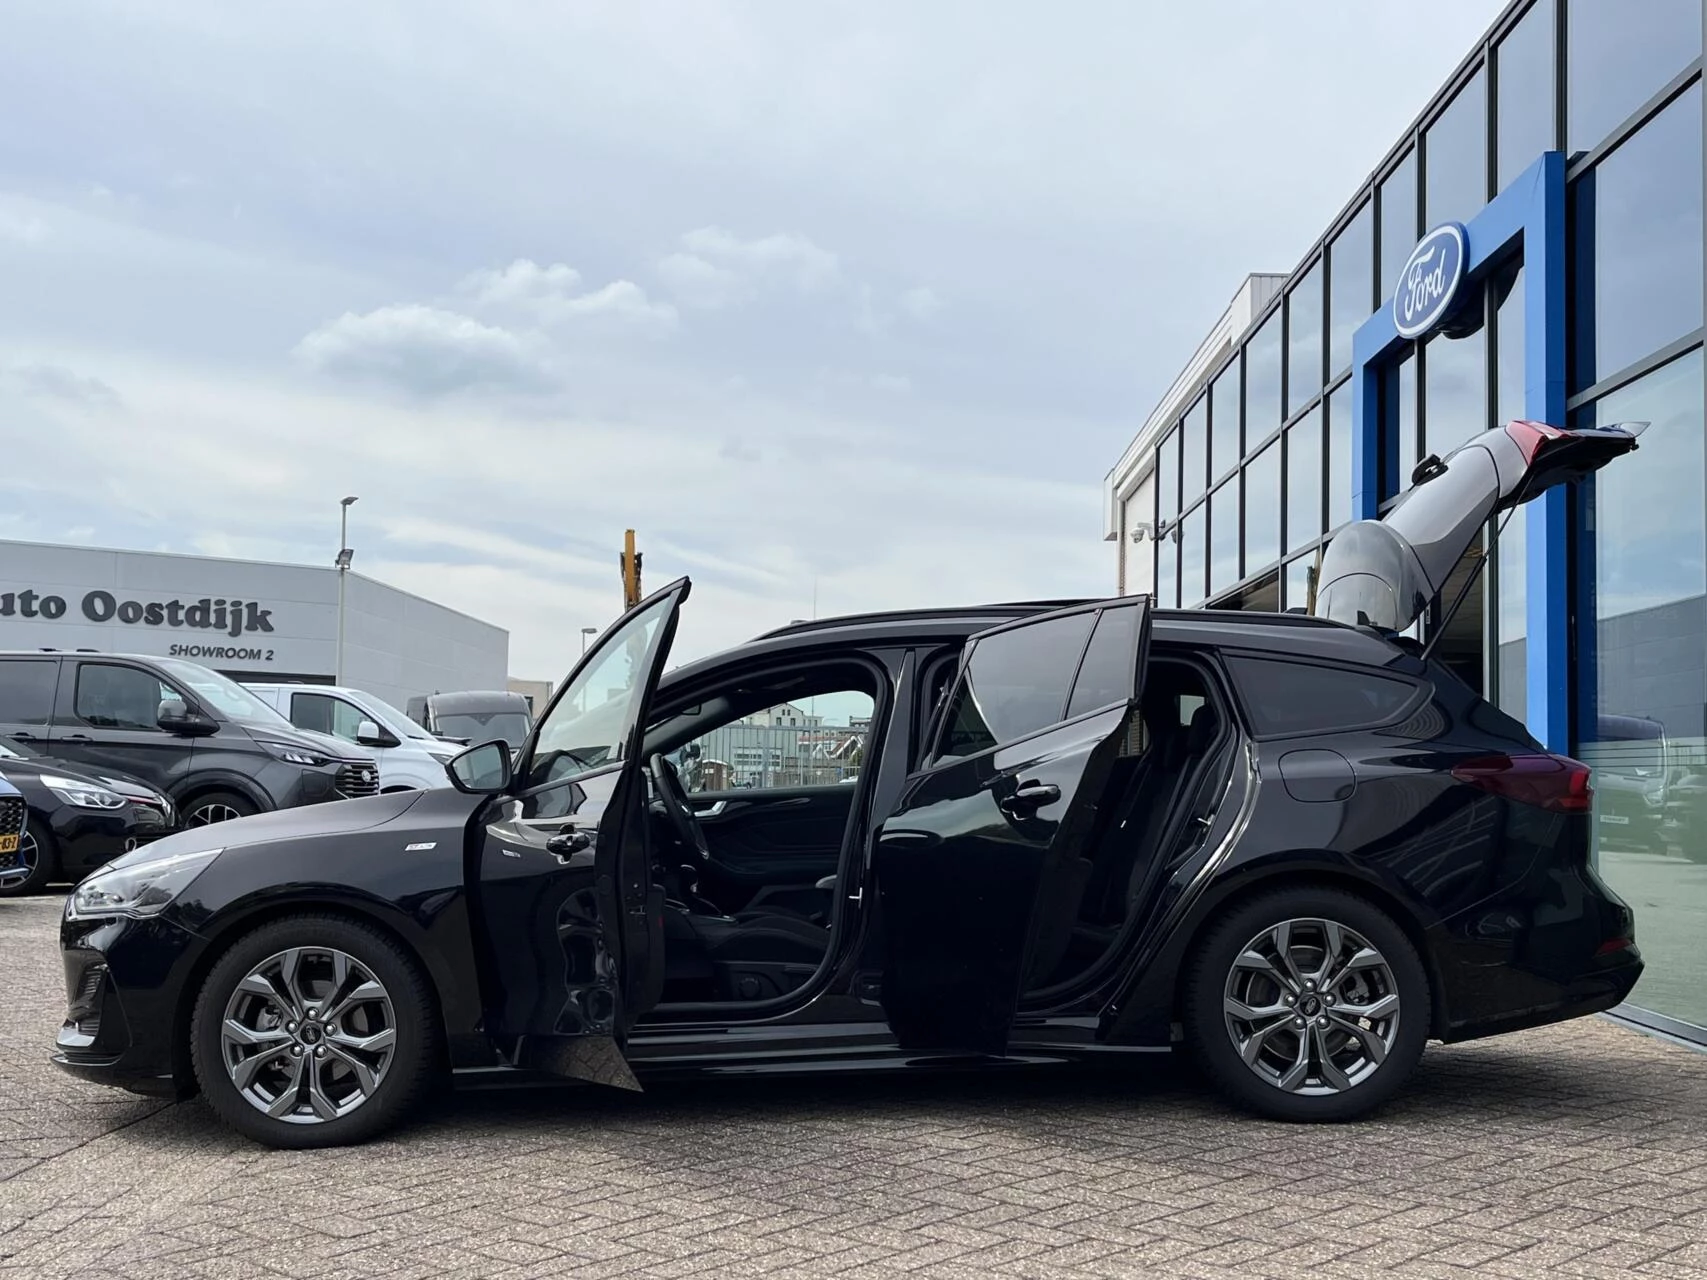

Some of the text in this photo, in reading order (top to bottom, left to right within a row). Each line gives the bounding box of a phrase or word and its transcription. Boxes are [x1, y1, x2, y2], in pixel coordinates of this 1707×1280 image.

[1404, 245, 1446, 322] Ford
[81, 590, 274, 637] Oostdijk
[169, 644, 274, 661] SHOWROOM 2
